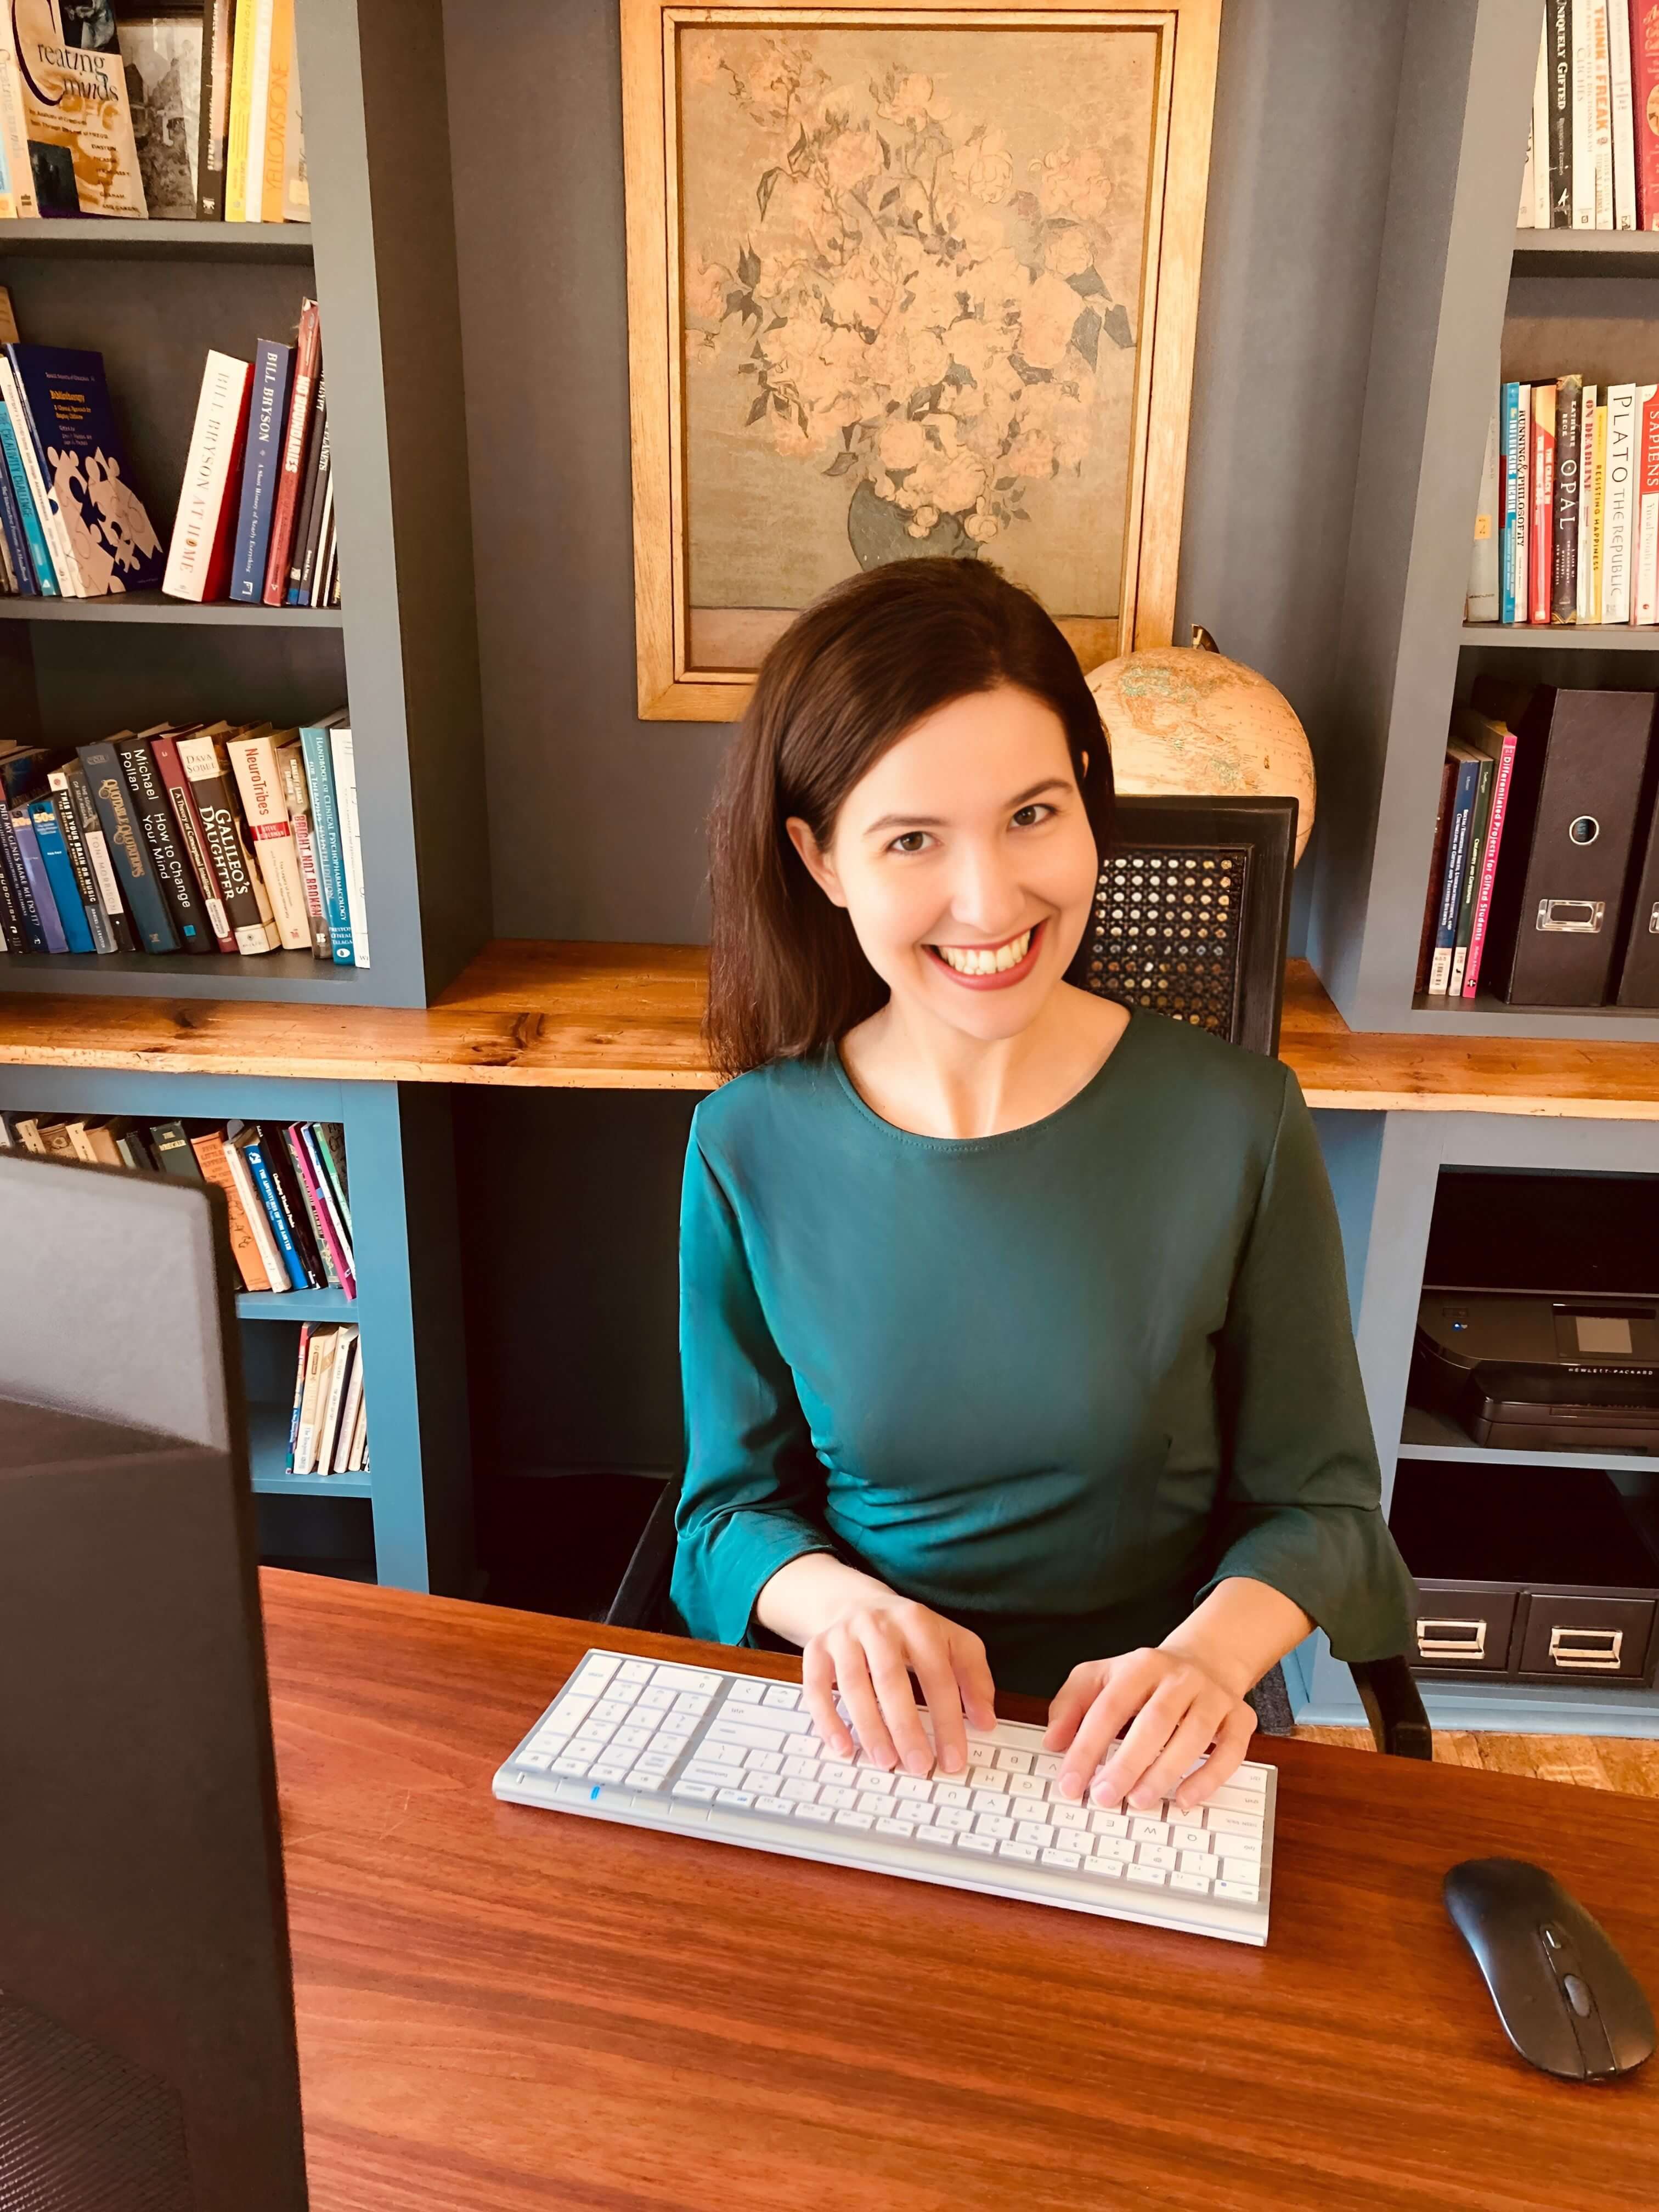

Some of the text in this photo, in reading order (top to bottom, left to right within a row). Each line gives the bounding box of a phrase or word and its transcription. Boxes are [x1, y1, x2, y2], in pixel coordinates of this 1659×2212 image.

[1557, 62, 1568, 110] GIFTED
[1594, 6, 1608, 130] THINK FREAK
[263, 60, 291, 191] YELLOWSTONE
[263, 352, 278, 383] BILL
[257, 387, 275, 442] BRYSON
[285, 376, 309, 473] NO BOUNDARIES
[1584, 399, 1593, 492] ON DEADLINE
[1, 427, 21, 473] CREATIVITY
[13, 474, 32, 518] CHALLENGE
[180, 372, 229, 573] BILL BRYSON AT HOME
[255, 469, 264, 486] Short
[1517, 463, 1527, 473] &
[1647, 411, 1659, 486] SAPIENS
[252, 487, 262, 510] History
[1516, 476, 1525, 546] PHILOSOPHY
[1558, 459, 1577, 530] OPAL
[1607, 395, 1633, 596] PLATO THE REPUBLIC
[244, 539, 256, 572] Everything
[248, 518, 258, 538] Nearly
[120, 751, 142, 792] Pollan
[132, 747, 161, 801] Michael
[187, 754, 212, 764] DAVA
[187, 761, 216, 773] SOBEL
[244, 747, 273, 816] NeuroTribes
[1493, 755, 1512, 820] Differentiated
[33, 812, 54, 822] 50s
[59, 791, 97, 902] THIS IS YOUR BRAIN ON MUSIC
[101, 777, 145, 879] QUOTABLE QUOTATIONS
[141, 815, 172, 880] Your Mind
[176, 799, 189, 823] Theory
[185, 830, 203, 866] Conceptual
[316, 737, 348, 921] HANDBOOK CLINICAL PSYCHOPHARMACOLOGY
[1487, 821, 1502, 857] Projects
[0, 803, 40, 927] DID MY GENES MAKE ME DO IT?
[91, 836, 117, 911] TONI MORRISON
[154, 812, 193, 909] How to Change
[198, 804, 236, 901] DAUGHTER
[214, 806, 252, 896] GALILEO'S
[292, 814, 323, 917] BRIGHT NOT BROKEN
[321, 861, 335, 899] EDITION
[1486, 859, 1496, 872] for
[1481, 874, 1493, 901] Gifted
[1474, 904, 1488, 941] Students
[1144, 1827, 1156, 1835] W
